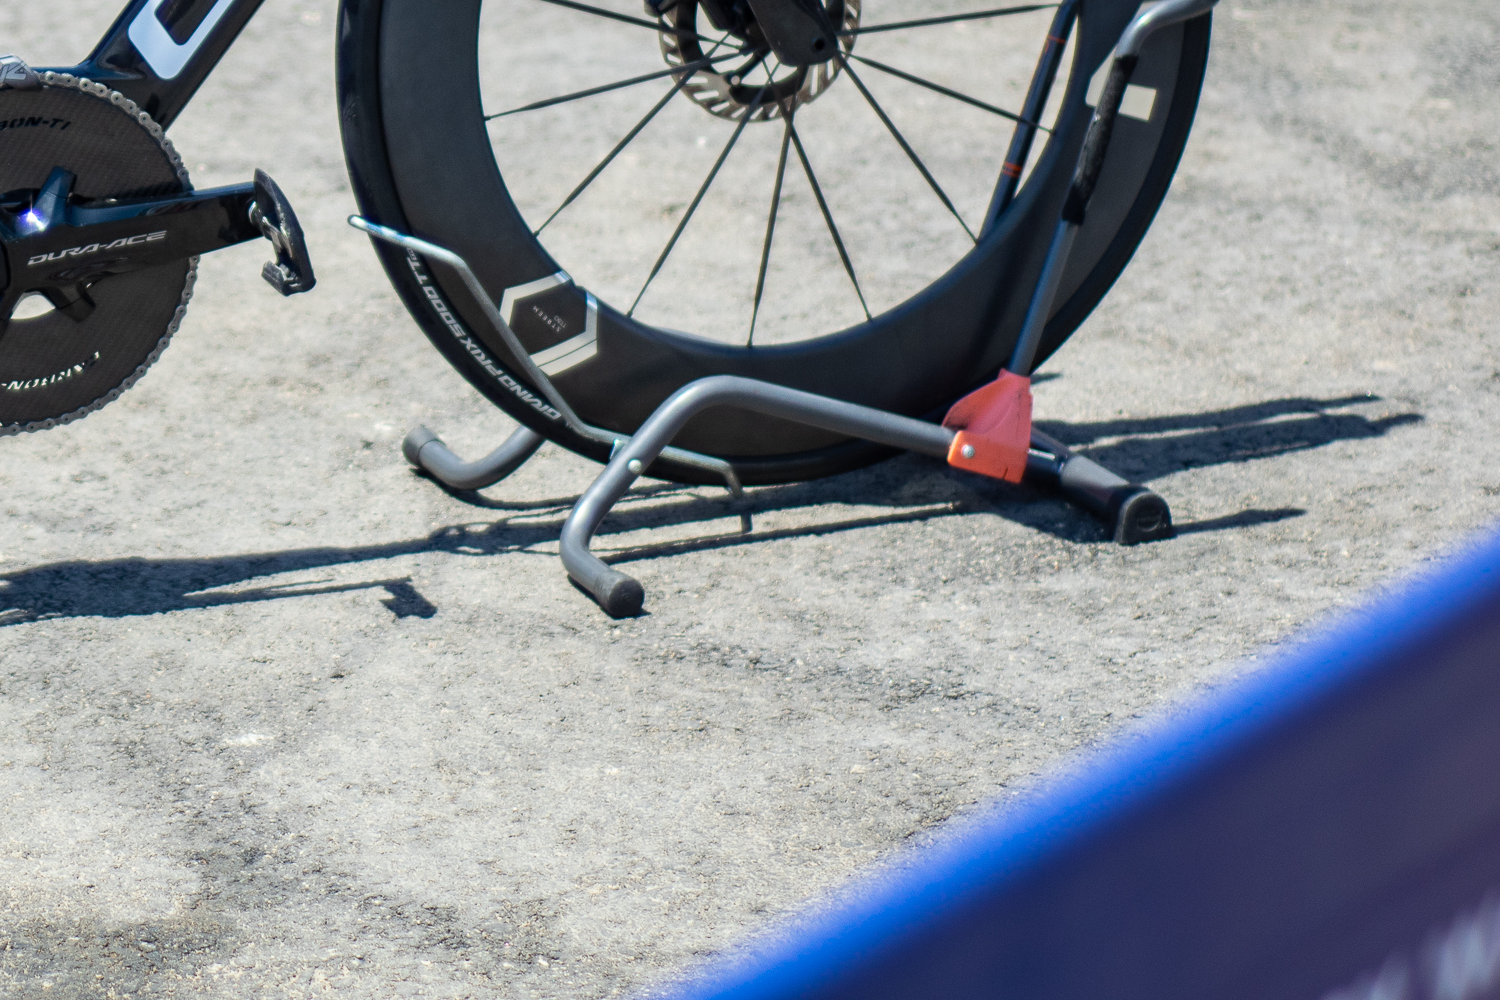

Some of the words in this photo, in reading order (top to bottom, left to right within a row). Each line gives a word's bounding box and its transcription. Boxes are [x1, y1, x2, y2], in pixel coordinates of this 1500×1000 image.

[27, 230, 167, 265] DURA-ACE
[422, 286, 466, 338] 5000
[461, 337, 503, 377] PRIX
[498, 375, 562, 420] GRAND
